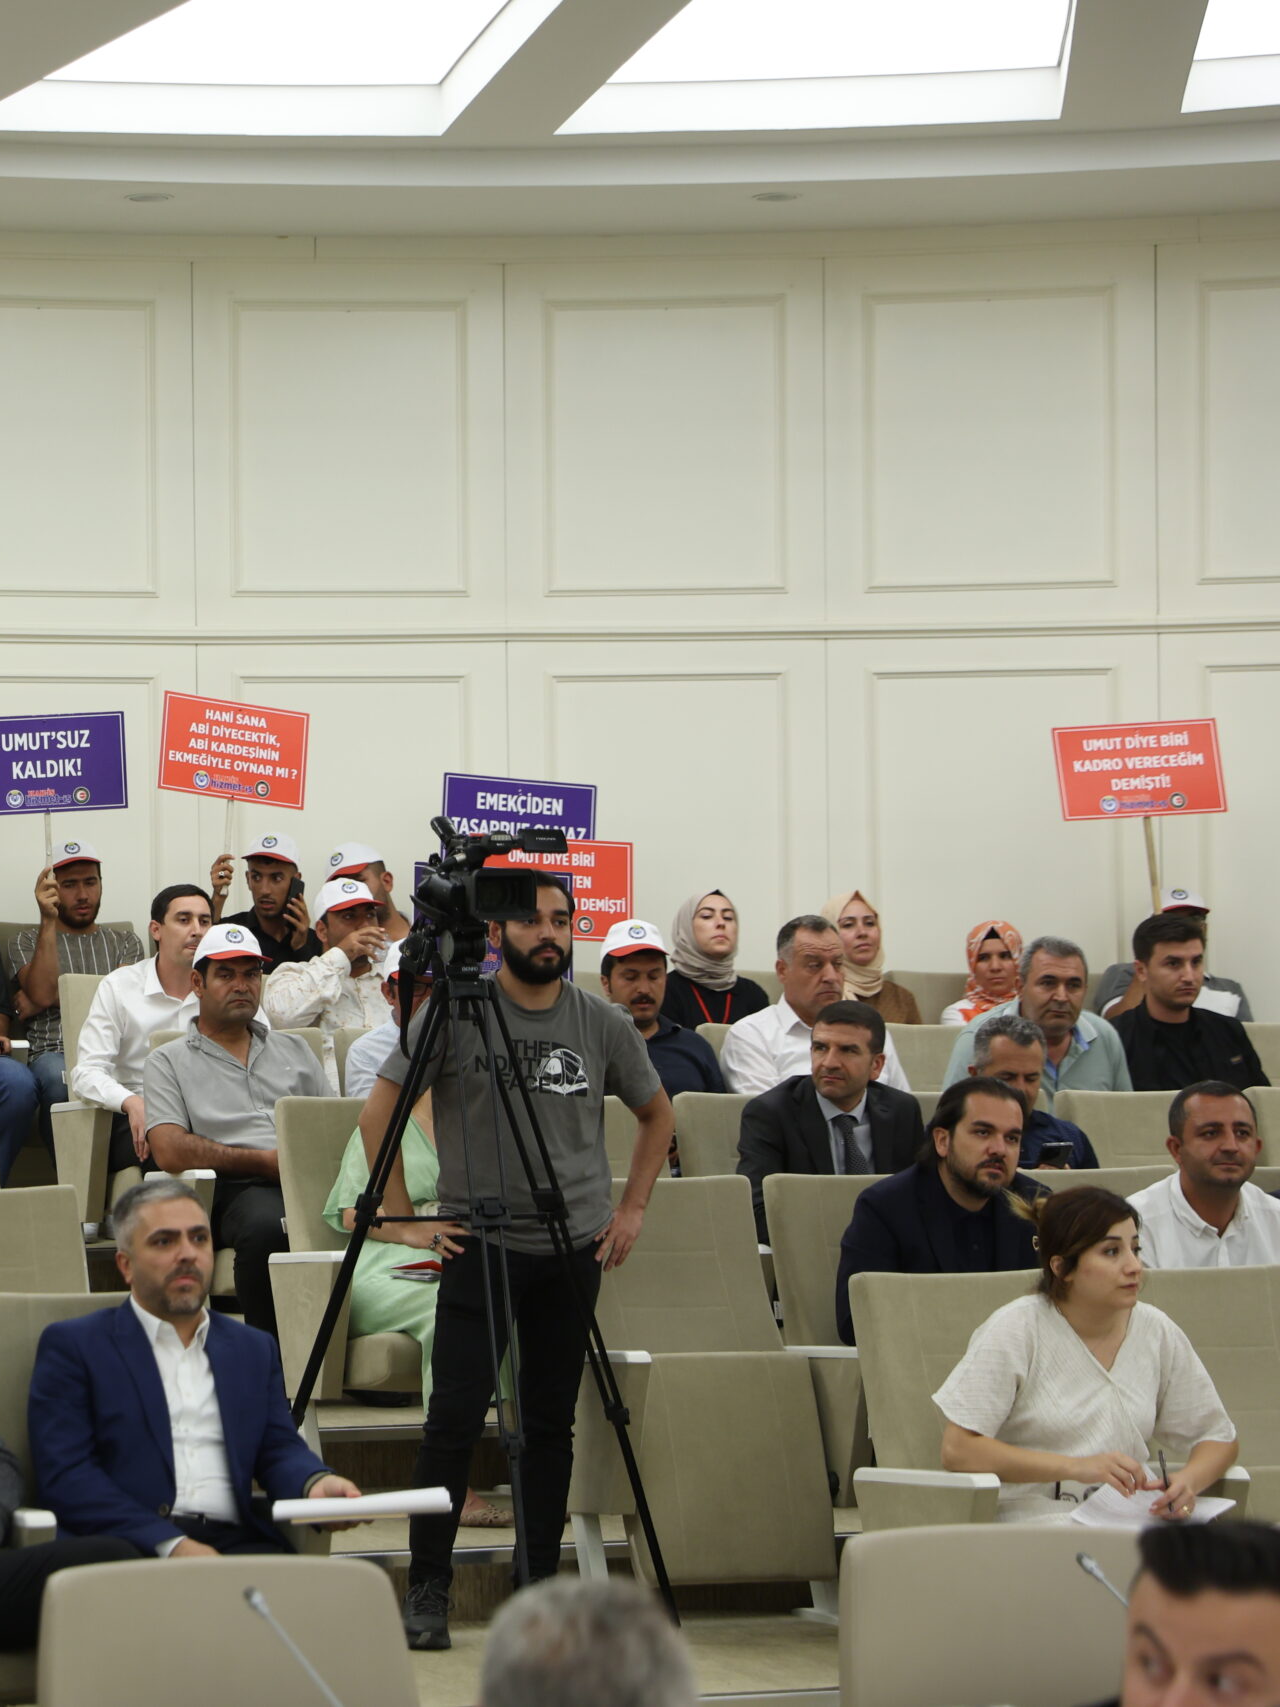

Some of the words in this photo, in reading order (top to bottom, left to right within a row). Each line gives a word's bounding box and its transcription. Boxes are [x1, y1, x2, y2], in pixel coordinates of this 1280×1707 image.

[205, 709, 234, 723] HANİ
[236, 714, 268, 729] SANA
[189, 722, 210, 735] ABİ
[212, 725, 281, 748] DİYECEKTİK,
[1082, 736, 1122, 751] UMUT
[1124, 733, 1158, 749] DİYE
[1160, 731, 1189, 747] BİRİ
[188, 738, 208, 750] ABİ
[211, 741, 280, 762] KARDEŞİNİN
[12, 758, 82, 780] KALDIK!
[168, 750, 232, 770] EKMEĞİYLE
[233, 760, 274, 776] OYNAR
[275, 767, 289, 779] MI
[1073, 758, 1123, 772] KADRO
[1125, 752, 1205, 769] VERECEĞİM
[1110, 773, 1172, 791] DEMİŞTİ!
[476, 791, 564, 816] EMEKÇİDEN
[508, 849, 540, 864] UMUT
[571, 851, 596, 867] BİRİ
[581, 896, 626, 914] DEMİŞTİ
[511, 1039, 550, 1058] THE
